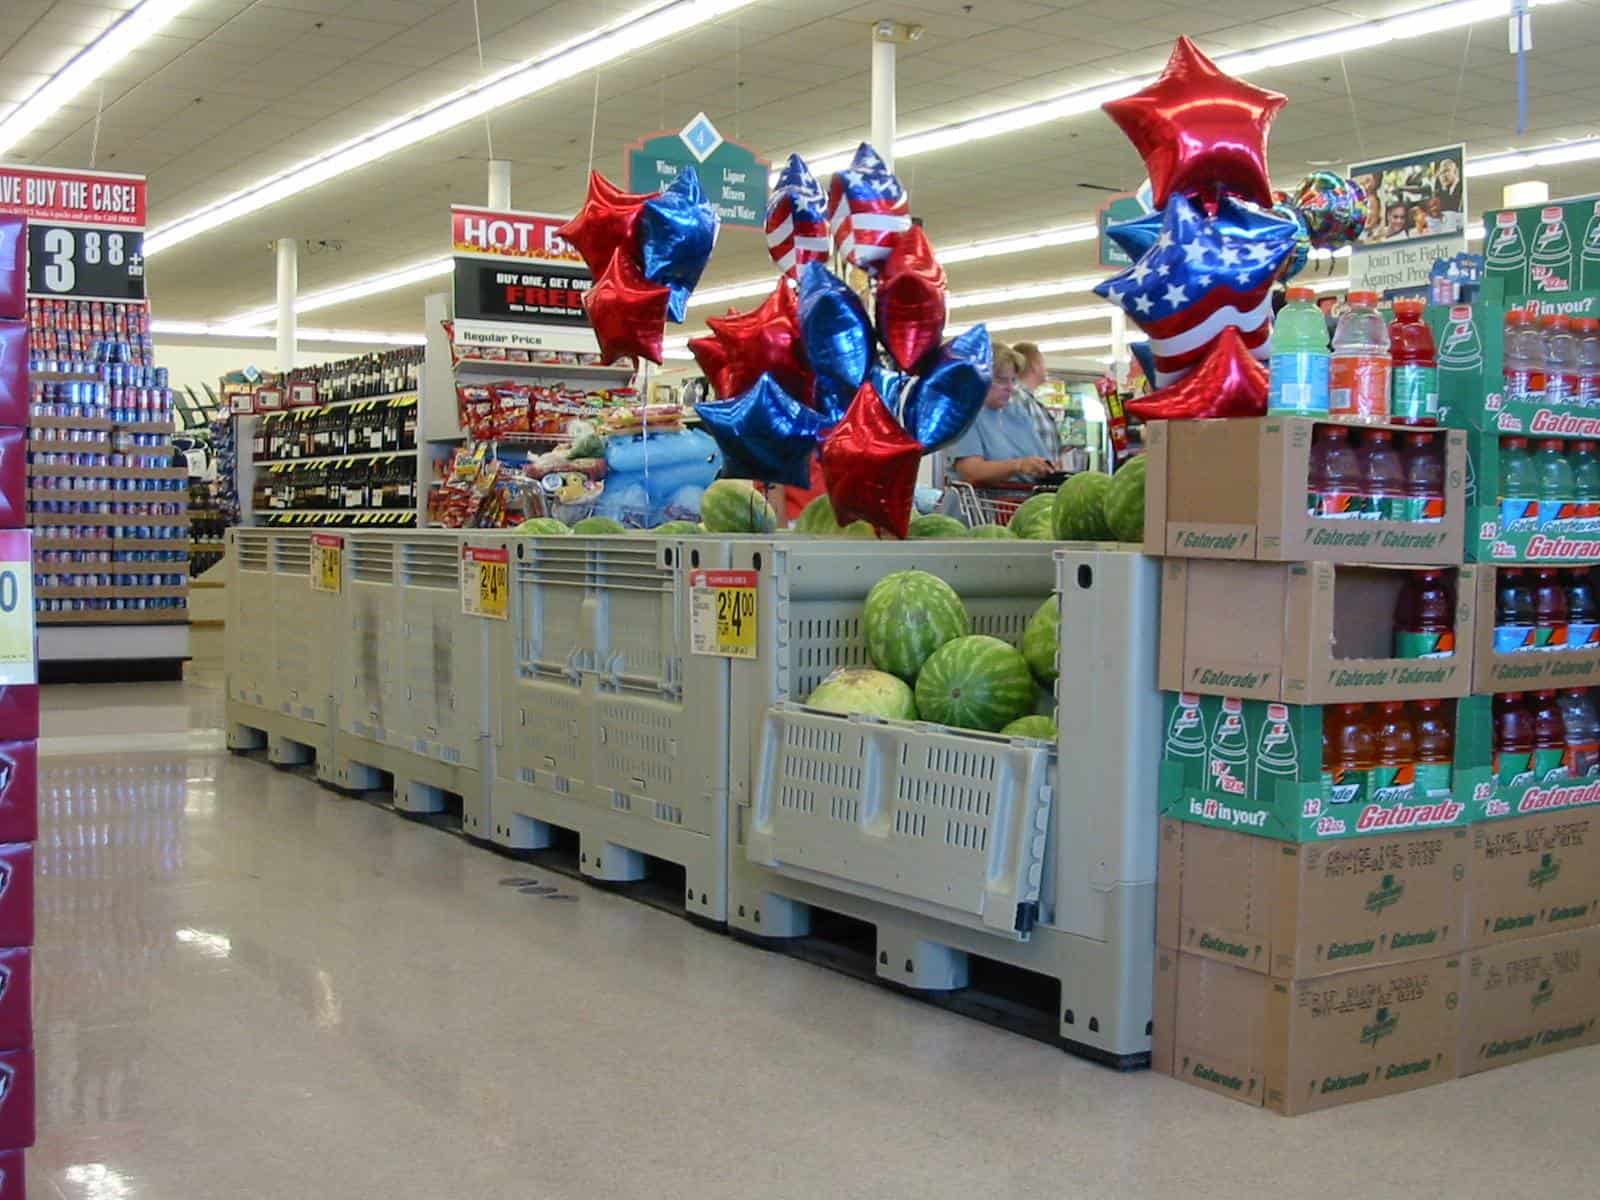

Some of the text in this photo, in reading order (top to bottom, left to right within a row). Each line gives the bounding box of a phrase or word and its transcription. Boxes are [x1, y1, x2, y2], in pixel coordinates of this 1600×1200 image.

[0, 176, 137, 212] VE BUY THE CASE!
[463, 218, 534, 251] HOT
[1368, 254, 1390, 271] Join
[1392, 249, 1417, 264] The
[496, 273, 519, 284] BUY
[549, 277, 569, 289] GET
[1360, 270, 1403, 288] Against
[1541, 301, 1556, 315] in
[1556, 297, 1592, 316] you?
[464, 332, 542, 345] Regular Price
[1184, 531, 1238, 550] Gatorade
[1313, 528, 1437, 548] Gatorade Gatorade
[1200, 669, 1257, 688] Gatorade
[1190, 798, 1268, 827] is it in you?
[1302, 799, 1321, 818] 12
[1356, 800, 1465, 831] Gatorade
